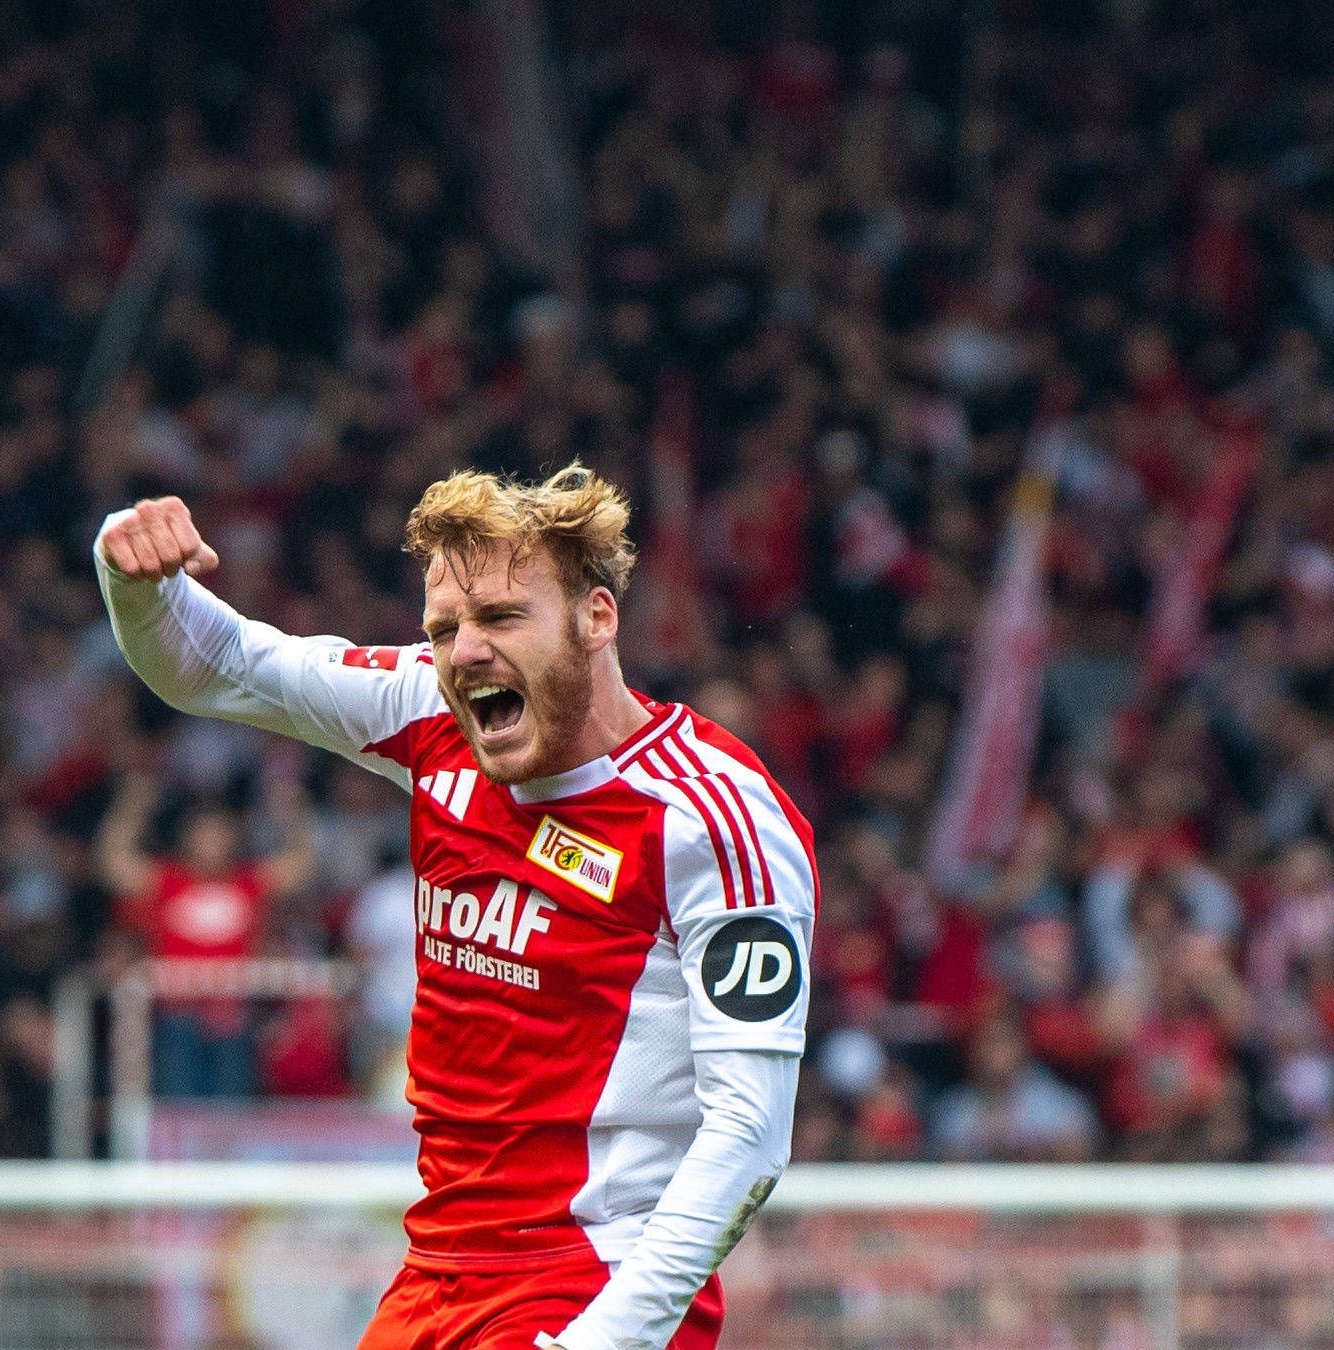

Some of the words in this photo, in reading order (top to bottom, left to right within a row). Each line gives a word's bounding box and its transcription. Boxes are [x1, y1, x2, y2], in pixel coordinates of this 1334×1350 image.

[580, 858, 613, 888] UNION
[417, 876, 559, 956] proAF
[425, 935, 452, 966] ALTE
[456, 944, 540, 990] FÖRSTEREI
[714, 942, 792, 996] JD
